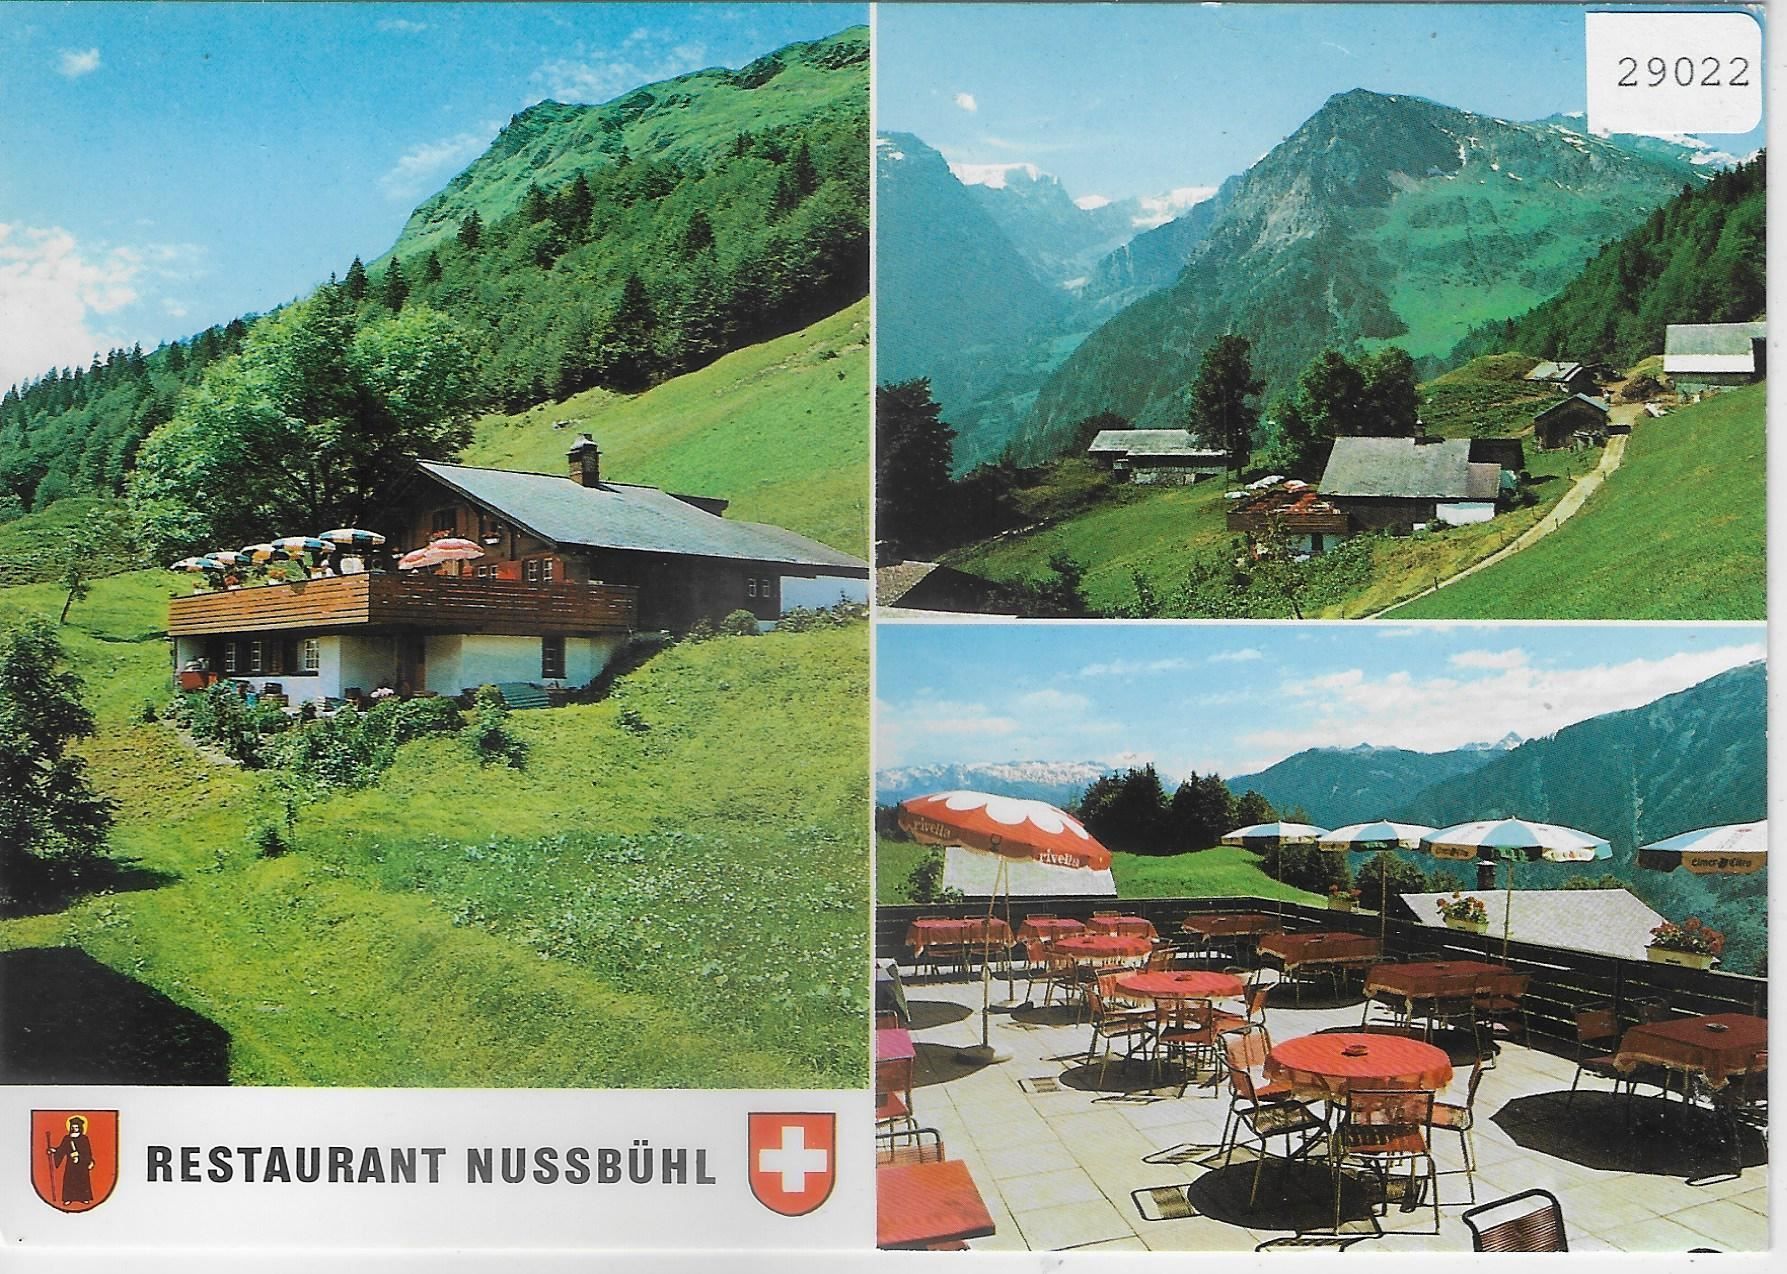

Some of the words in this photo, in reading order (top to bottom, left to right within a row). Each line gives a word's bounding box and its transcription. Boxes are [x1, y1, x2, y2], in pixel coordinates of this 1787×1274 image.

[1617, 56, 1749, 88] 29022
[913, 817, 951, 839] rivella
[1039, 848, 1080, 867] rivella
[147, 1145, 446, 1184] RESTAURANT
[467, 1140, 716, 1185] NUSSBÜHL
